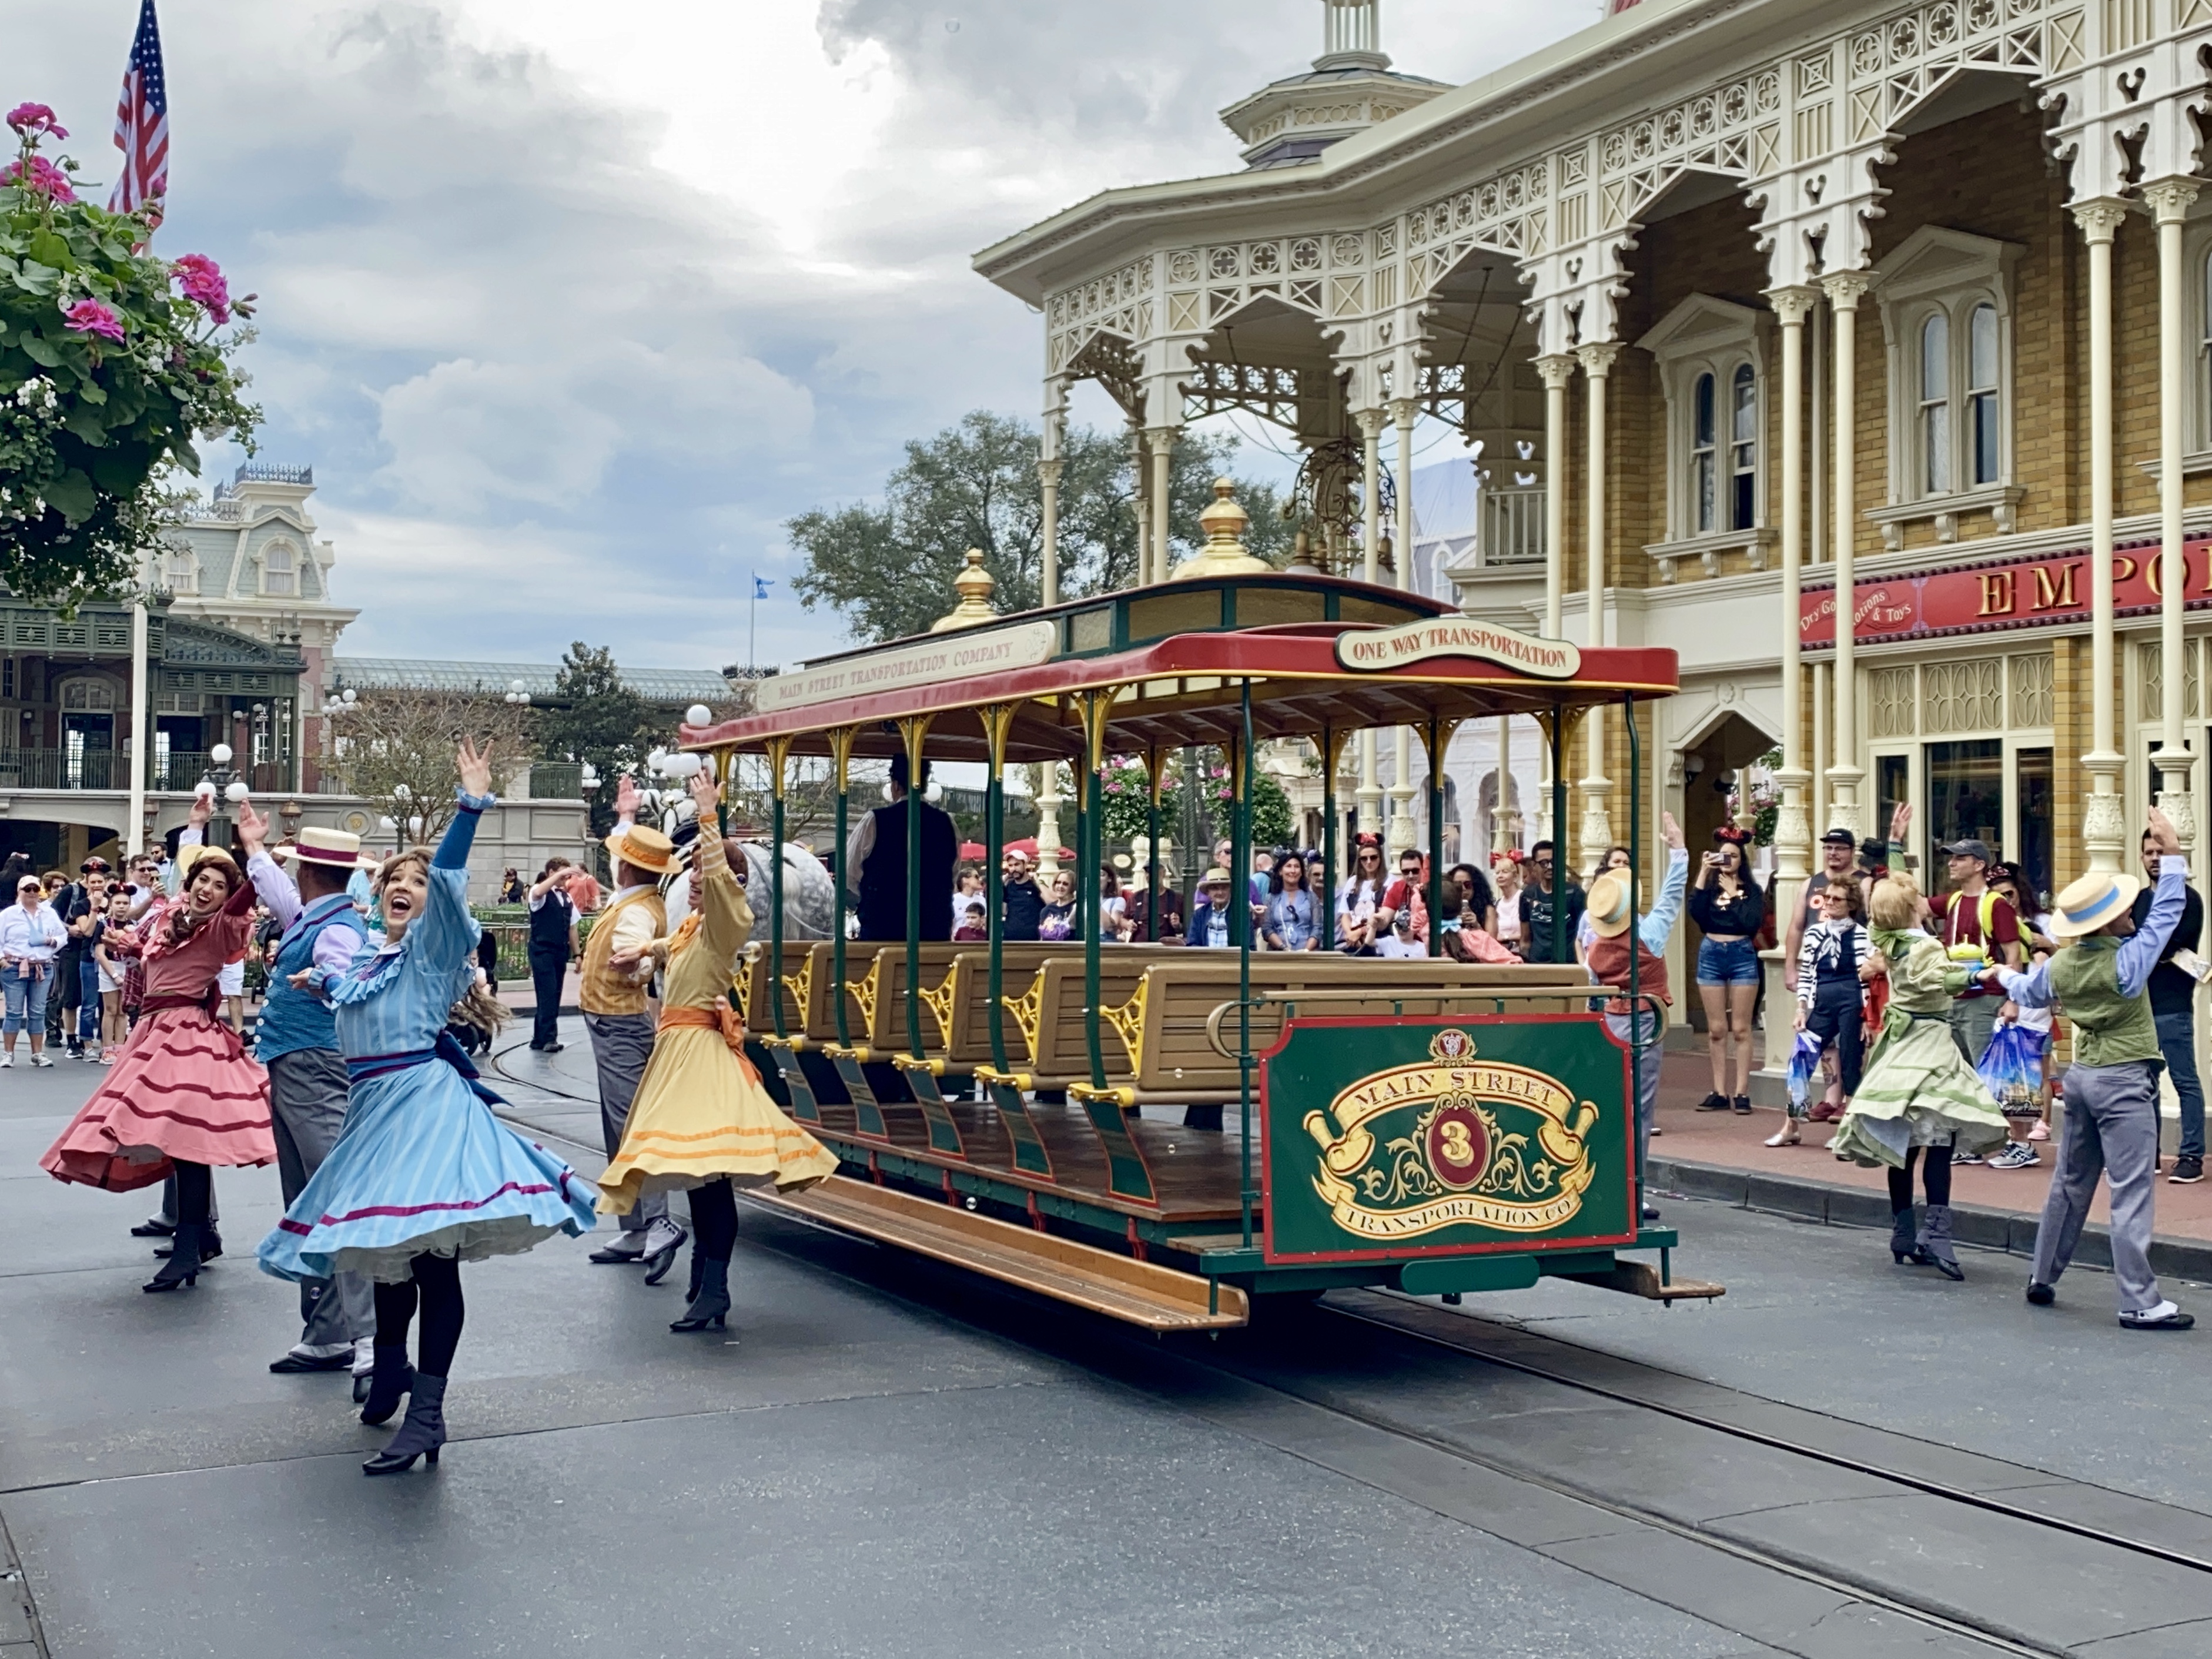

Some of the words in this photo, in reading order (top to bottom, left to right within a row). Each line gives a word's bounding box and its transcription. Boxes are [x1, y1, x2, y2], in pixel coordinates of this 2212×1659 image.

[1975, 545, 2212, 617] EMPO
[1801, 608, 1819, 631] Dry
[1853, 591, 1886, 626] otions
[1873, 607, 1880, 621] &
[1886, 603, 1912, 621] Toys
[1353, 641, 1387, 660] ONE
[1390, 631, 1424, 657] WAY
[1426, 627, 1567, 667] TRANSPORTATION
[779, 682, 804, 700] MAIN
[808, 673, 845, 694] STREET
[850, 654, 948, 685] TRANSPORTATION
[953, 641, 1014, 667] COMPANY
[1354, 1073, 1435, 1112] MAIN
[1450, 1071, 1556, 1107] STREET
[1441, 1121, 1474, 1168] 3
[1346, 1200, 1540, 1232] TRANSPORTATION
[1545, 1199, 1571, 1221] CO
